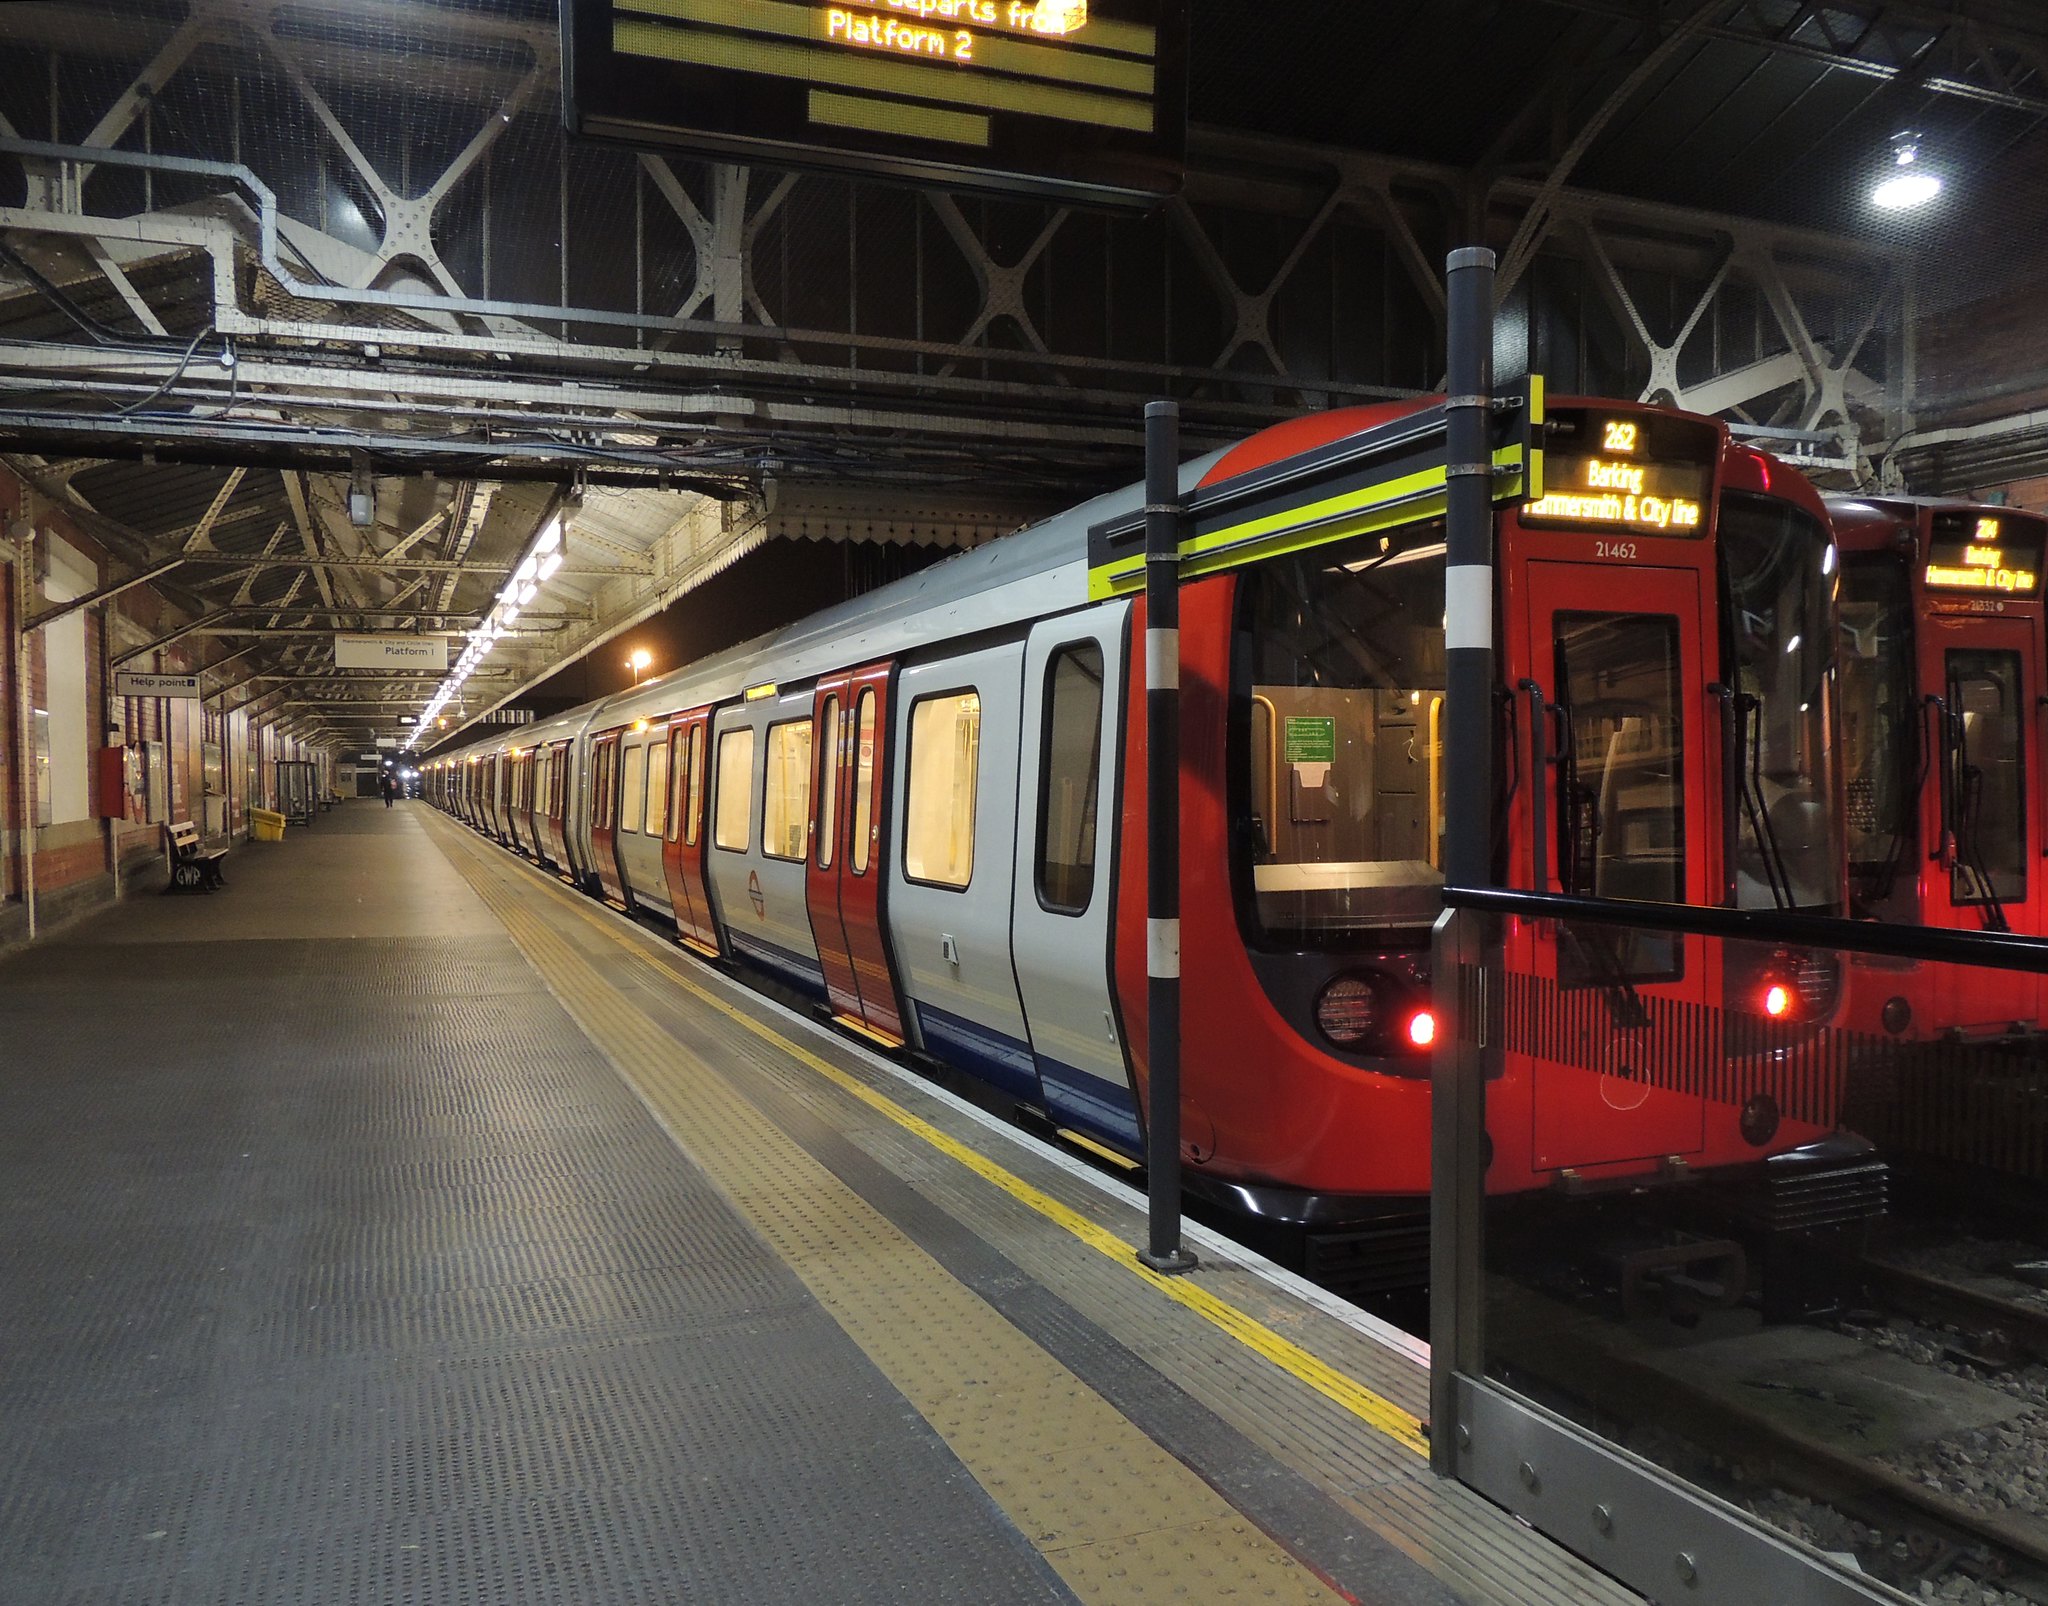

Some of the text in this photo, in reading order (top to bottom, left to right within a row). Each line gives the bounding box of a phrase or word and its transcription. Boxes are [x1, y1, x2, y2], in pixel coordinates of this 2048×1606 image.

[828, 9, 972, 58] Platform 2
[1604, 422, 1636, 451] 262
[1588, 460, 1643, 494] Barking
[1624, 495, 1637, 520] &
[1640, 496, 1671, 527] City
[1672, 499, 1699, 524] line
[1595, 541, 1637, 559] 21462
[385, 646, 428, 656] Platform
[130, 677, 186, 688] Help point
